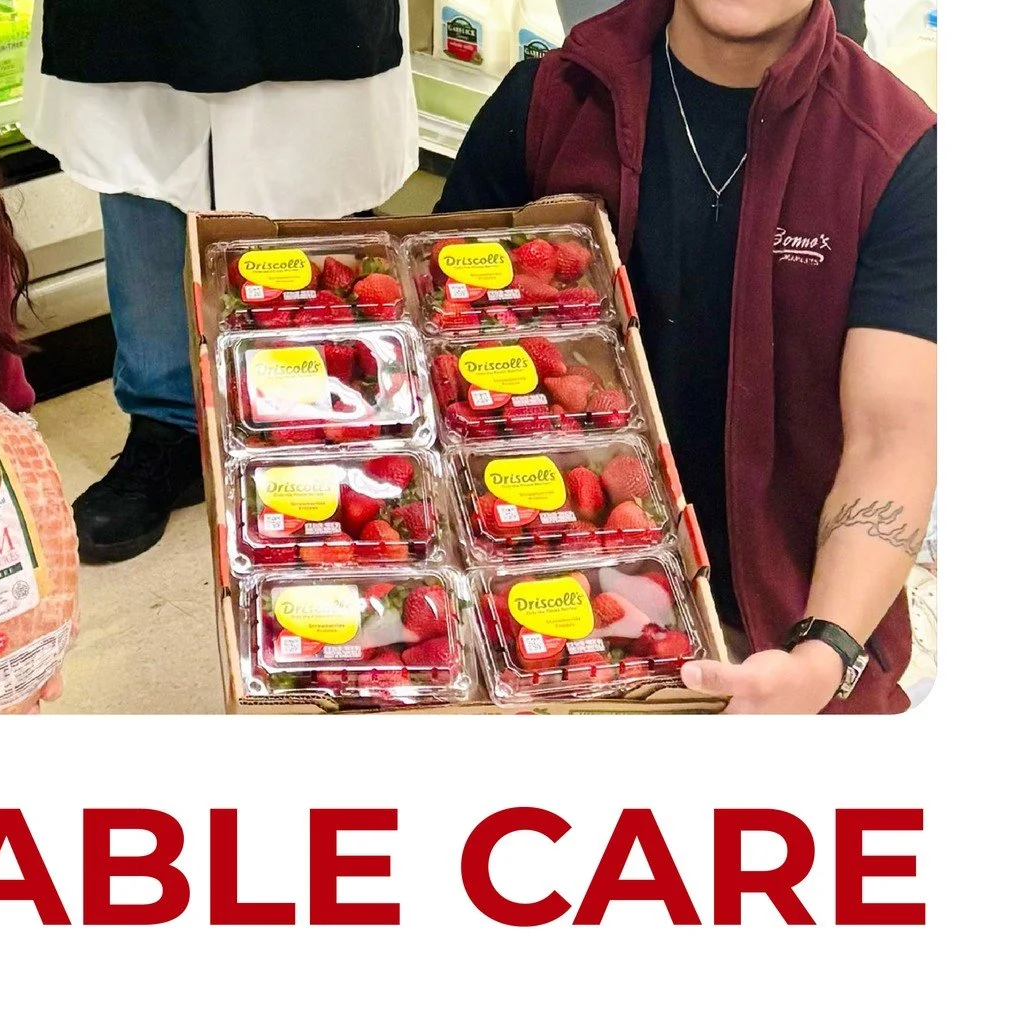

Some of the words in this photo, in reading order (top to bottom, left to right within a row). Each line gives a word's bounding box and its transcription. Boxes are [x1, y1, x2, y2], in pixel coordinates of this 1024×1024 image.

[773, 226, 832, 251] Bonne's
[244, 258, 307, 271] Driscoll's
[444, 254, 506, 267] Driscoll's
[256, 360, 321, 376] Driscoll's
[464, 357, 528, 373] Driscoll's
[490, 469, 557, 485] Driscoll's
[514, 592, 584, 611] Driscoll's
